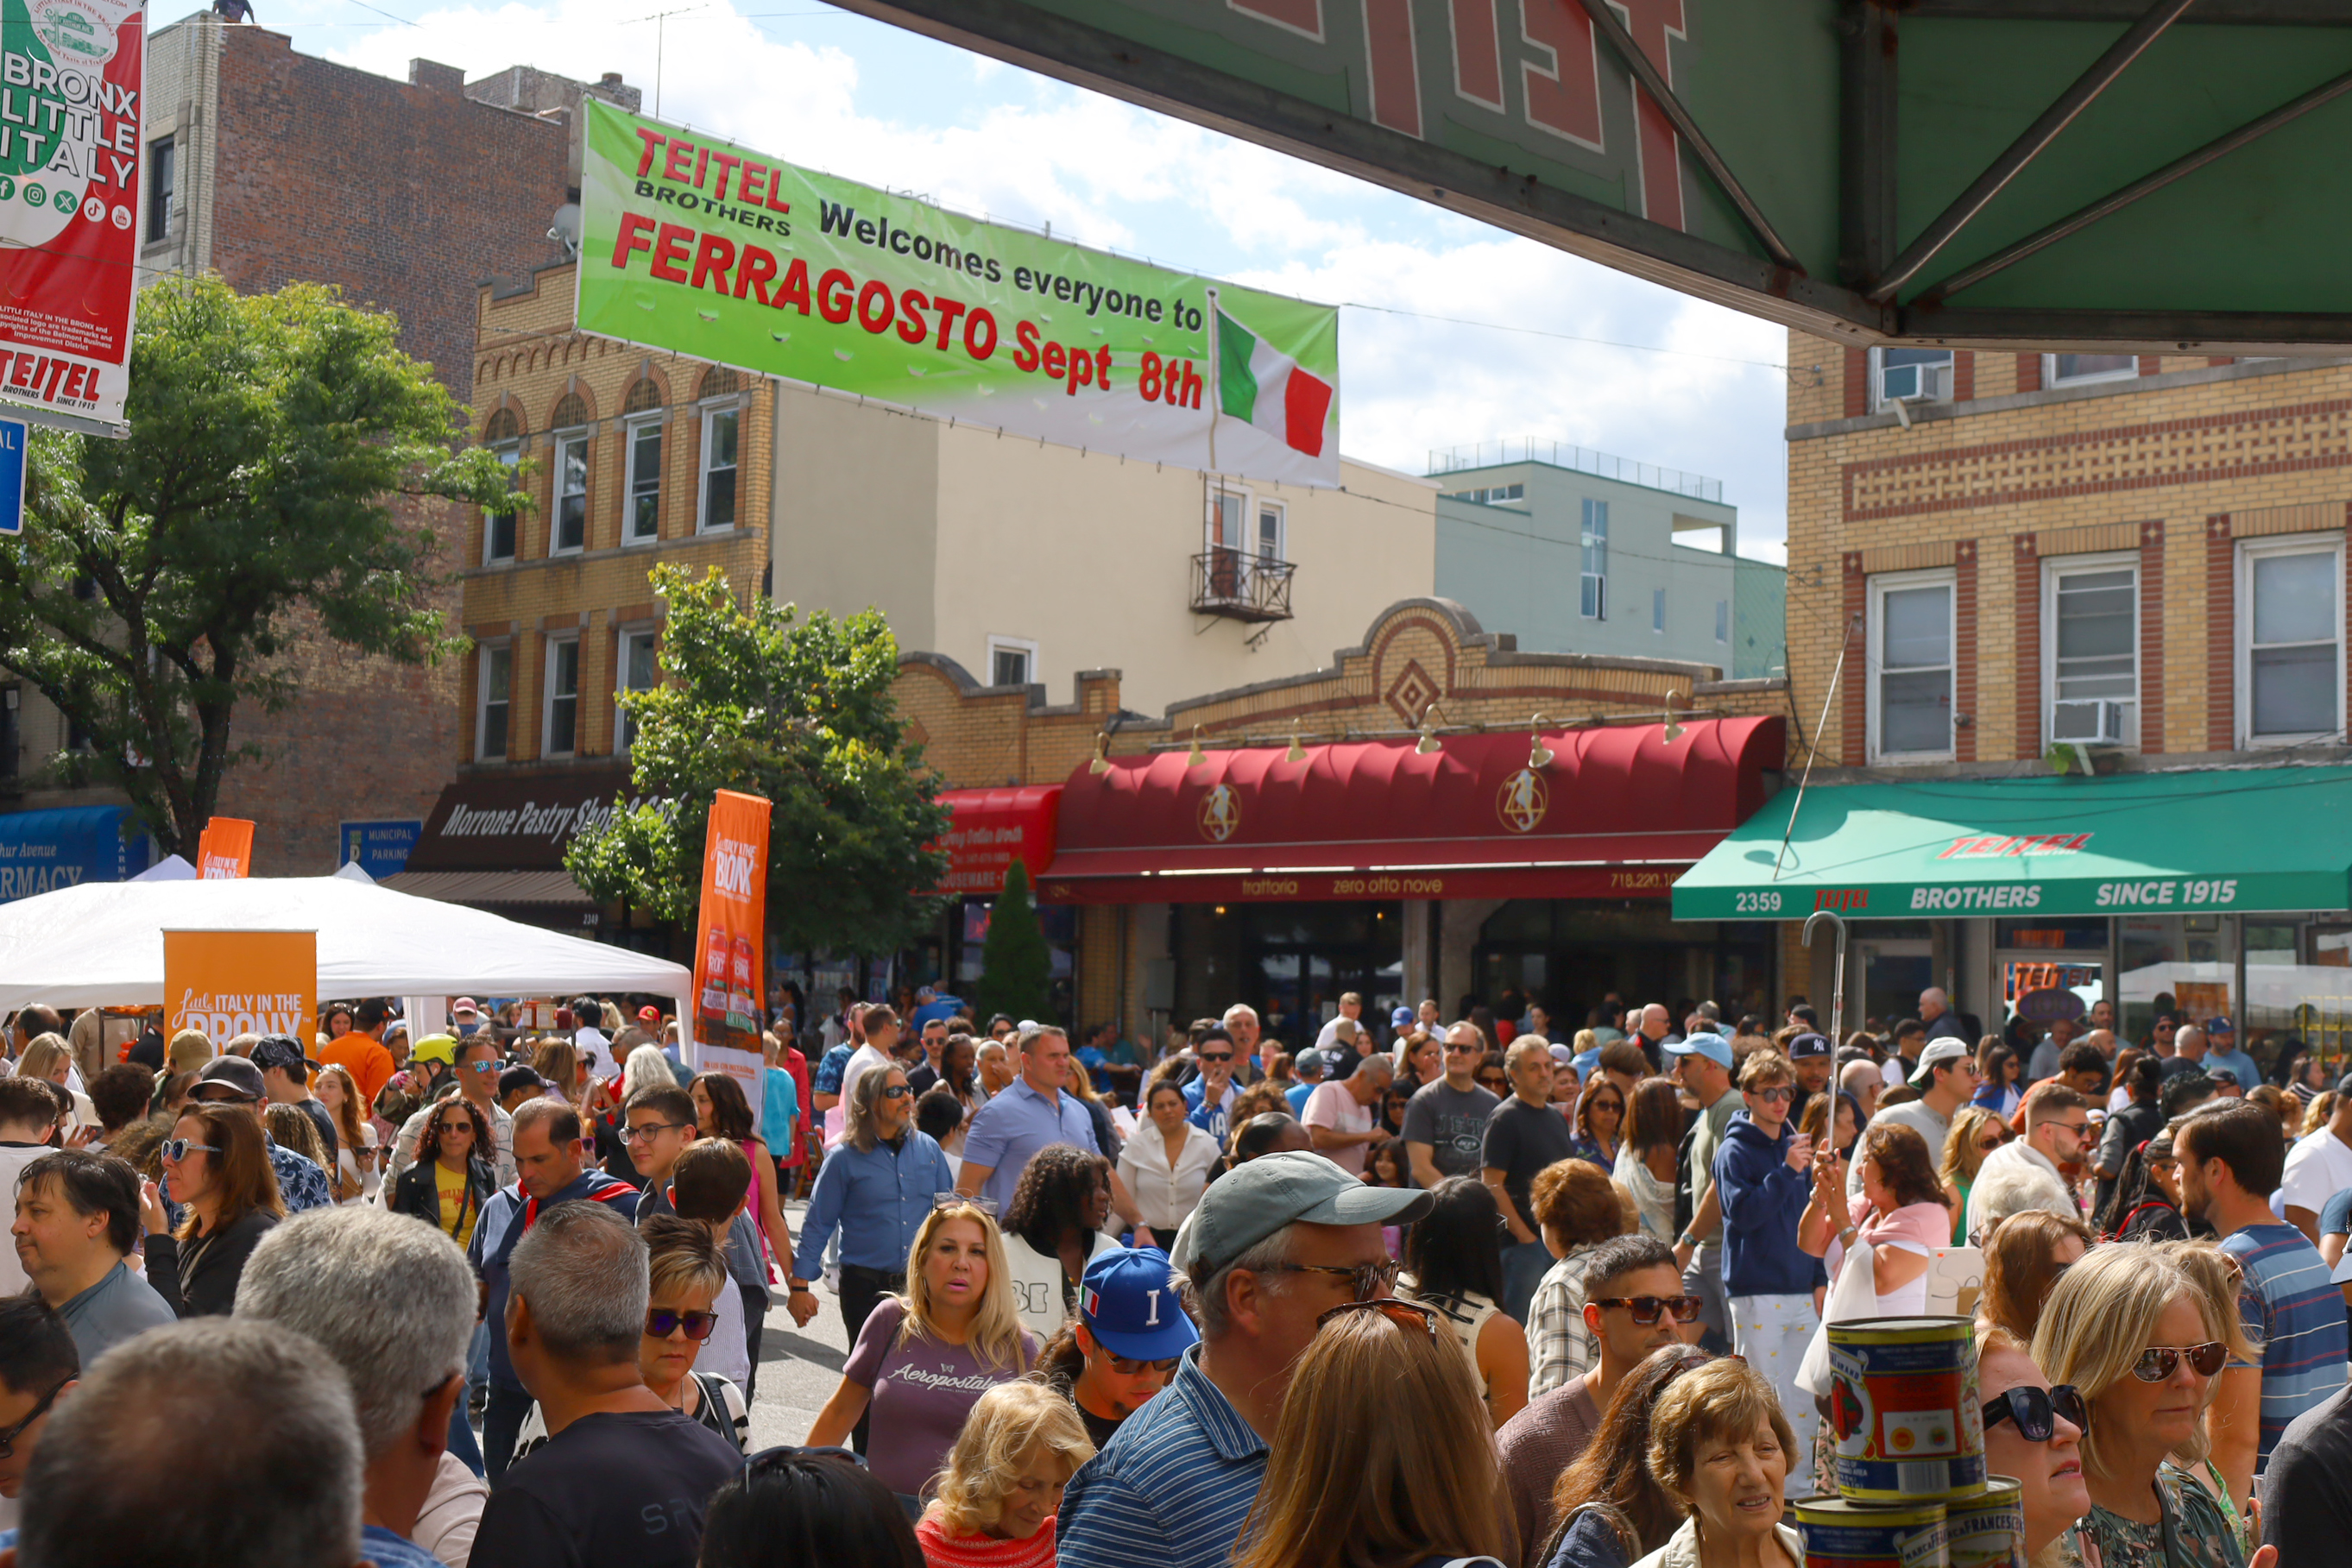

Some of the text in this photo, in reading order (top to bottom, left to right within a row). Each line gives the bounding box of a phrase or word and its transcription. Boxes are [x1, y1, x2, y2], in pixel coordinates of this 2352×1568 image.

[3, 51, 138, 122] BRONX
[1, 87, 136, 157] LITTLE
[0, 125, 135, 191] ITALY
[636, 125, 791, 215] TEITEL
[634, 179, 791, 236] BROTHERS
[819, 198, 1203, 331] Welcomes everyone to
[0, 305, 22, 316] LITTLE
[23, 310, 44, 319] ITALY
[54, 316, 69, 324] THE
[70, 319, 95, 331] BRONX
[611, 211, 1203, 410] FERRAGOSTO Sept 8th
[14, 331, 89, 351] Improvement District
[30, 318, 47, 329] logo
[61, 324, 99, 339] trademarks
[100, 334, 113, 343] and
[39, 328, 52, 337] the
[53, 331, 82, 343] Belmont
[84, 337, 112, 349] Business
[0, 349, 100, 402] TEITEL
[3, 384, 96, 411] BROTHERS SINCE 1915
[369, 828, 413, 841] MUNICIPAL
[440, 803, 516, 836] Morrone
[512, 801, 576, 844] Pastry
[19, 841, 57, 858] Avenue
[371, 848, 408, 860] PARKING
[1935, 833, 2095, 860] TEITEL
[1242, 878, 1299, 897] trattoria
[1333, 880, 1365, 893] zero
[1368, 877, 1400, 893] otto
[1403, 879, 1443, 893] nove
[1736, 879, 2238, 912] 2359 TEITEL BROTHERS SINCE 1915
[2016, 967, 2094, 991] TEITEL
[171, 987, 302, 1030] Little ITALY IN THE
[1145, 1288, 1161, 1326] I
[887, 1363, 999, 1391] Aeropostale
